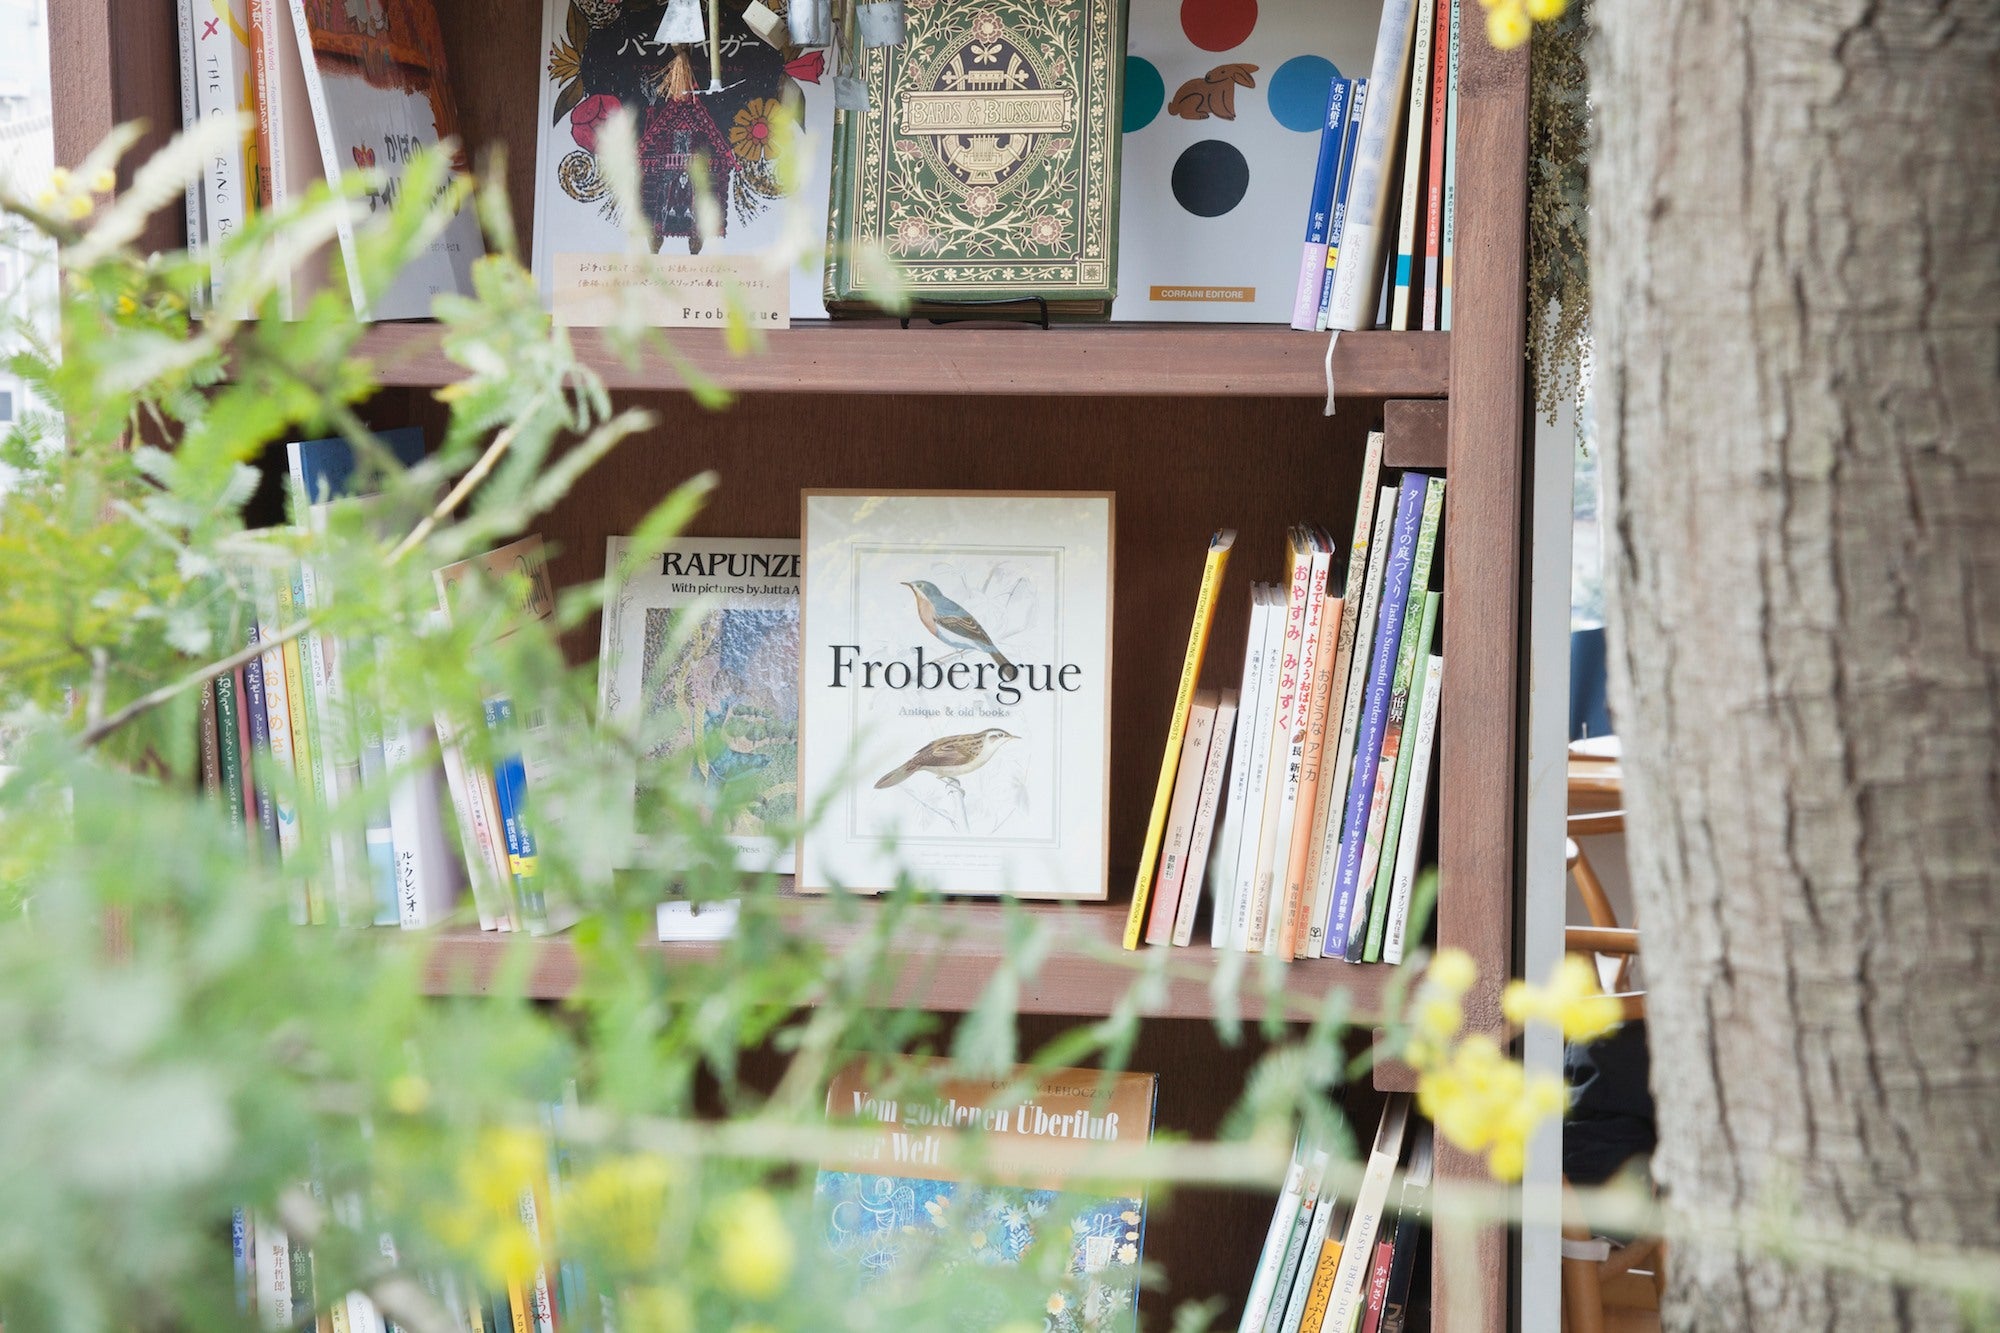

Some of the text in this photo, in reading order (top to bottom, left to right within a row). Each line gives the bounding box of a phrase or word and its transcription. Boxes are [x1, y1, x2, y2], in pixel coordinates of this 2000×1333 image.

[206, 54, 222, 93] THE
[267, 47, 275, 71] World
[910, 97, 1065, 126] BARDS & BLOSSOMS
[1328, 83, 1345, 130] 花の民俗学
[1160, 289, 1245, 299] CORRAINI EDITORE
[661, 552, 801, 578] RAPUNZE
[1392, 489, 1419, 600] ターシャの庭づくり
[672, 582, 801, 597] With pictures by Jutta A
[1363, 518, 1387, 621] イグナツとちょうちょう
[1184, 661, 1194, 677] AND
[1278, 564, 1309, 731] おやすみ みみずく
[1294, 568, 1327, 727] はるですよ ふくろうおばさん
[1370, 601, 1400, 725] Tasha's Successful Garden
[827, 644, 1083, 706] Frobergue
[898, 705, 1012, 719] Antique & old books
[1177, 677, 1190, 717] GRINNING
[1419, 685, 1439, 746] 春のめざめ
[1170, 717, 1183, 741] GHOSTS
[1304, 668, 1331, 782] おりこうな アニカ
[1288, 761, 1301, 784] 新太
[1291, 745, 1302, 757] 長
[737, 844, 760, 854] Press
[1132, 875, 1147, 924] CLARION BOOKS
[1392, 875, 1408, 946] スタジオジブリ責任編集
[852, 1090, 1120, 1142] Vom goldenen Überfluß
[890, 1132, 942, 1165] Welt
[1337, 1300, 1349, 1316] DU
[1354, 1213, 1374, 1262] CASTOR
[1369, 1265, 1387, 1312] かぜさん
